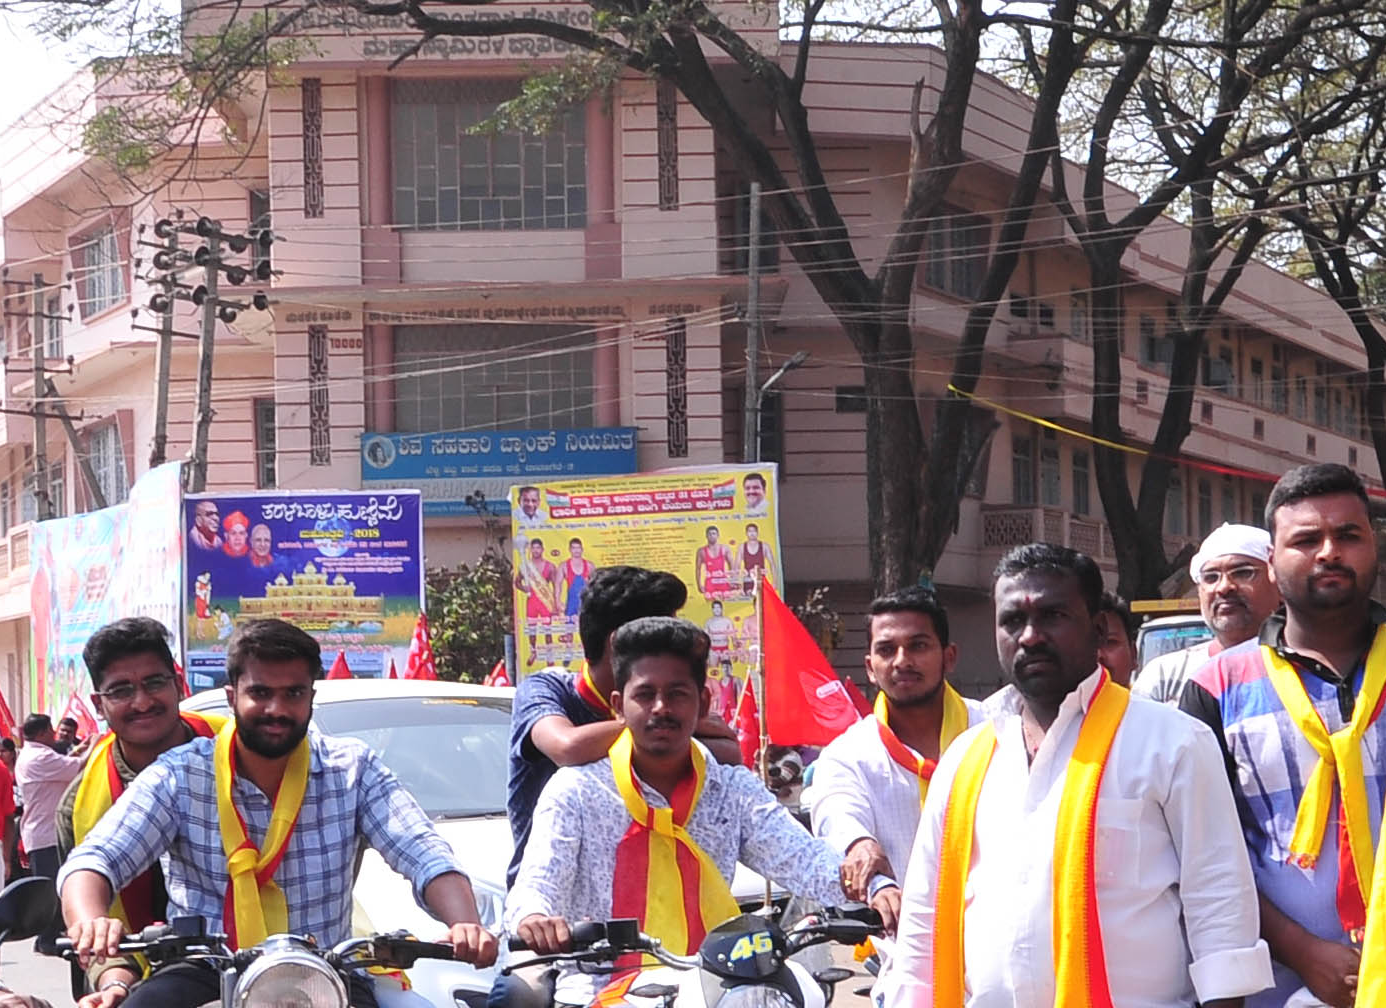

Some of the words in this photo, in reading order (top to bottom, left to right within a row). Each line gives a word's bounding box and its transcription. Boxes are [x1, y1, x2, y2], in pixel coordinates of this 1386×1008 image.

[431, 435, 492, 455] ಸಹಕಾರಿ
[500, 430, 557, 463] ಬ್ಯಾಂಕ್
[565, 432, 634, 451] ನಿಯಮಿತ
[730, 930, 774, 962] 46
